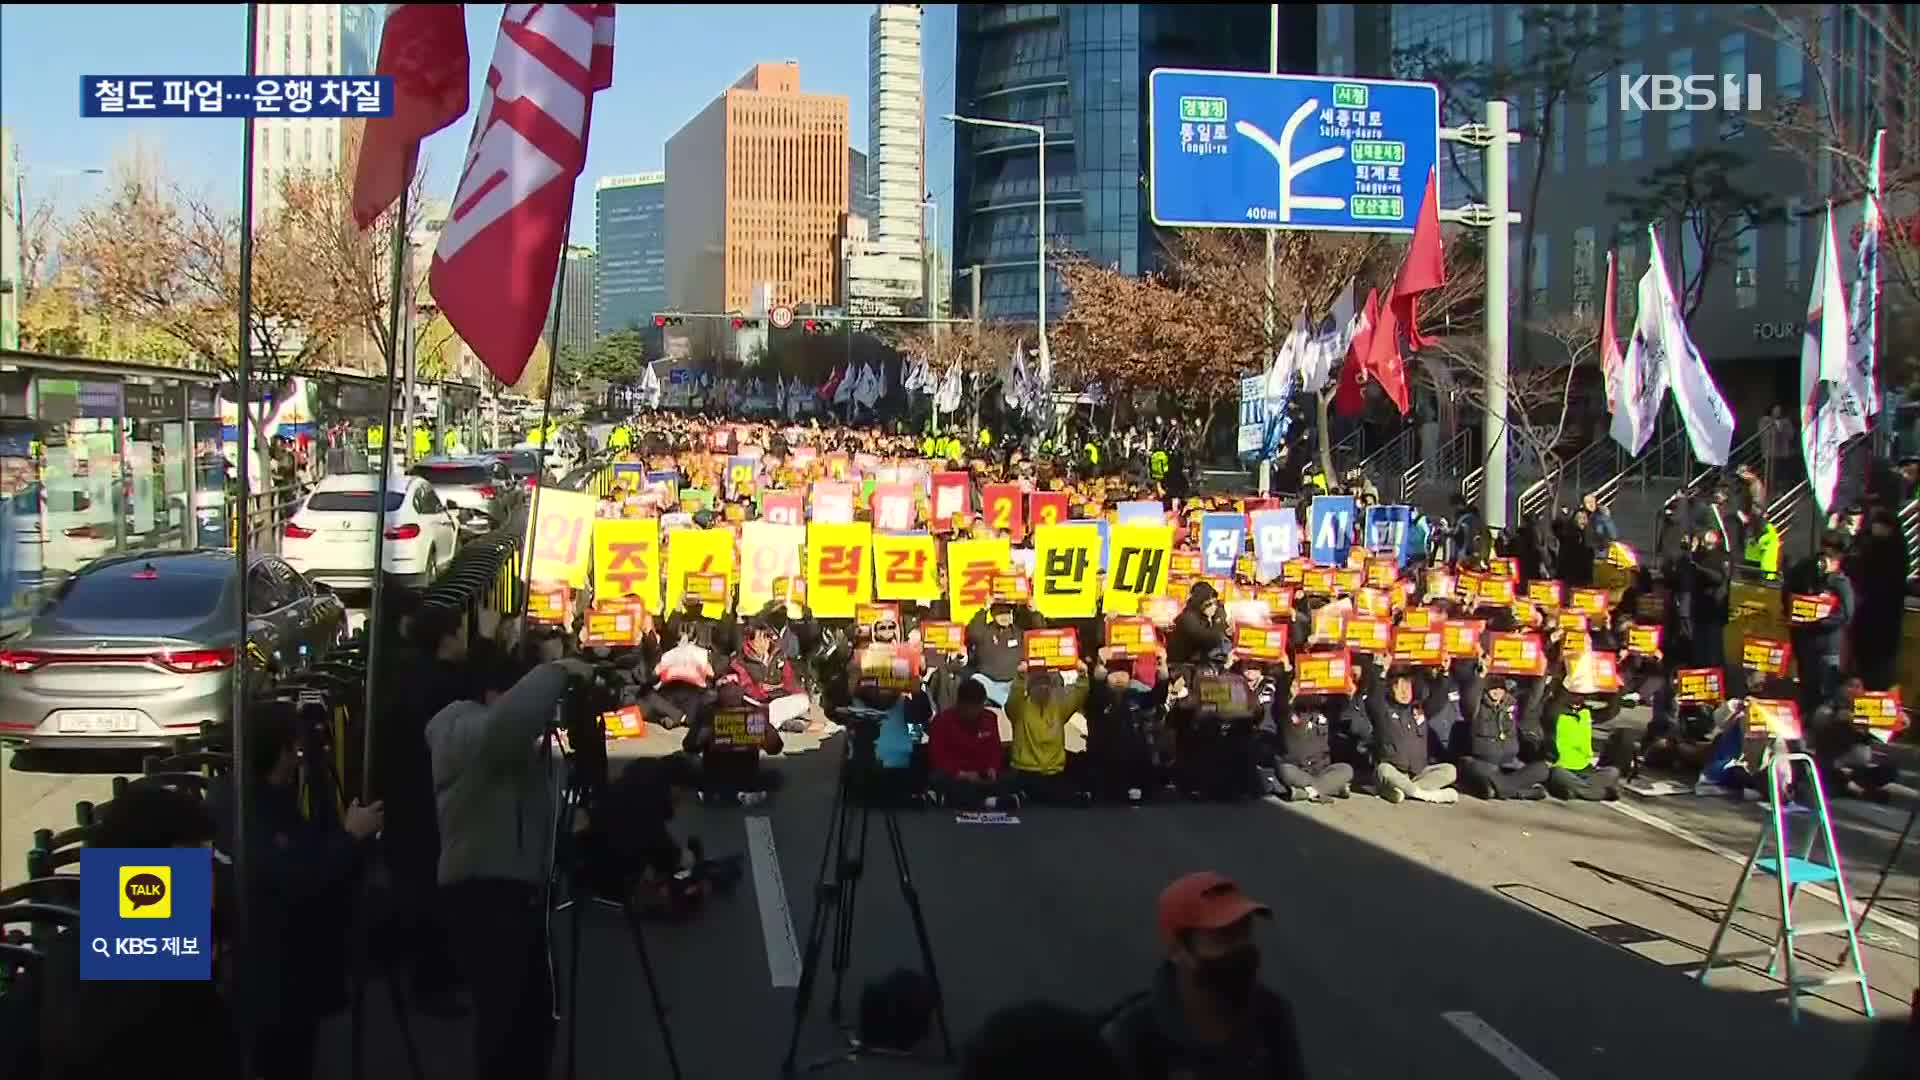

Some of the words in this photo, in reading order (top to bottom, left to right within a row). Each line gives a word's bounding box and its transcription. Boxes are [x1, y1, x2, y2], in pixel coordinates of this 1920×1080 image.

[1338, 87, 1365, 105] 시청
[1183, 100, 1225, 118] 경찰청
[1319, 108, 1383, 128] 세종대로
[1180, 123, 1229, 142] 통일로
[1354, 144, 1402, 161] 남대문시장
[1355, 165, 1401, 181] 퇴계로
[1245, 207, 1278, 220] 400m
[1354, 198, 1401, 216] 남산공원
[1041, 545, 1165, 596] 반대
